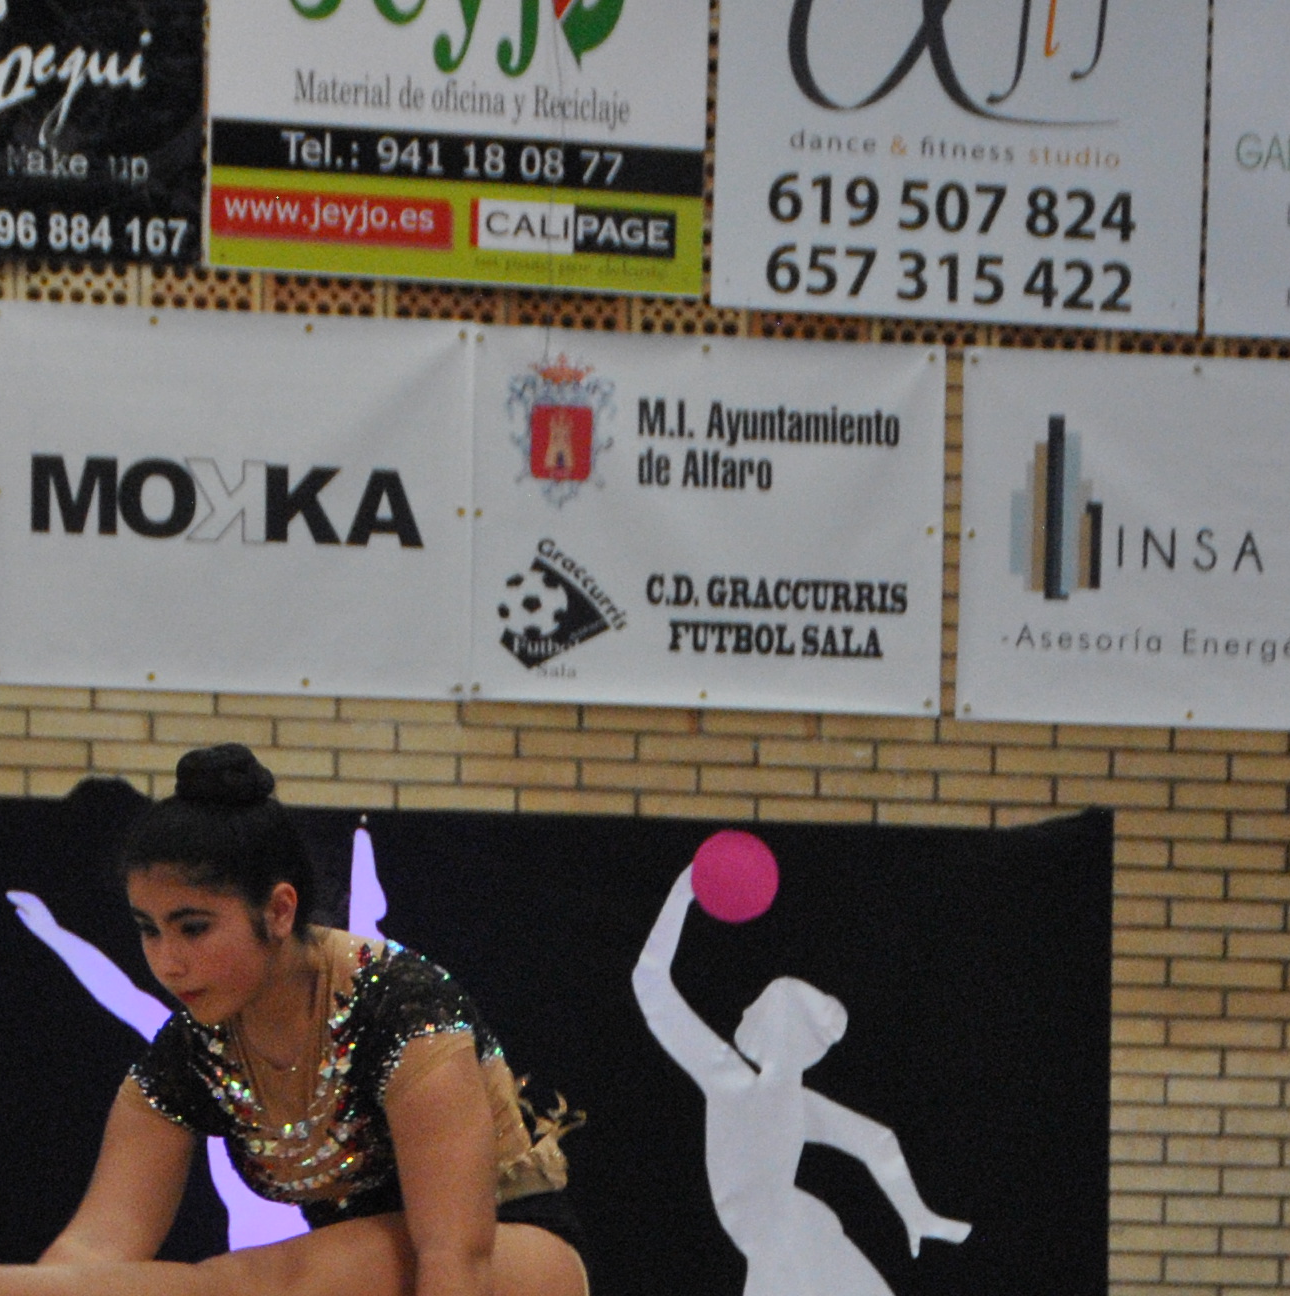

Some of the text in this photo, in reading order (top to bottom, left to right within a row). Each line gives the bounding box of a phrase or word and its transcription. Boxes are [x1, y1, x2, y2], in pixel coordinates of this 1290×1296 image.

[294, 68, 631, 130] Material de oficina y Reciclaje
[281, 131, 624, 185] Tel.: 941 18 08 77
[789, 129, 876, 155] dance
[920, 136, 1014, 164] fitness
[1028, 146, 1120, 169] studio
[224, 195, 436, 236] www.jeyjo.es
[768, 171, 1136, 242] 619 507 824
[48, 212, 112, 251] 884
[126, 216, 188, 256] 167
[765, 243, 1132, 313] 657 315 422
[637, 397, 900, 447] M.I. Ayuntamiento
[637, 447, 773, 491] de Alfaro
[1117, 524, 1264, 574] INSA
[537, 538, 628, 631] Graccurris
[646, 573, 908, 615] C.D. GRACCURRIS
[669, 619, 883, 660] FUTBOL SALA
